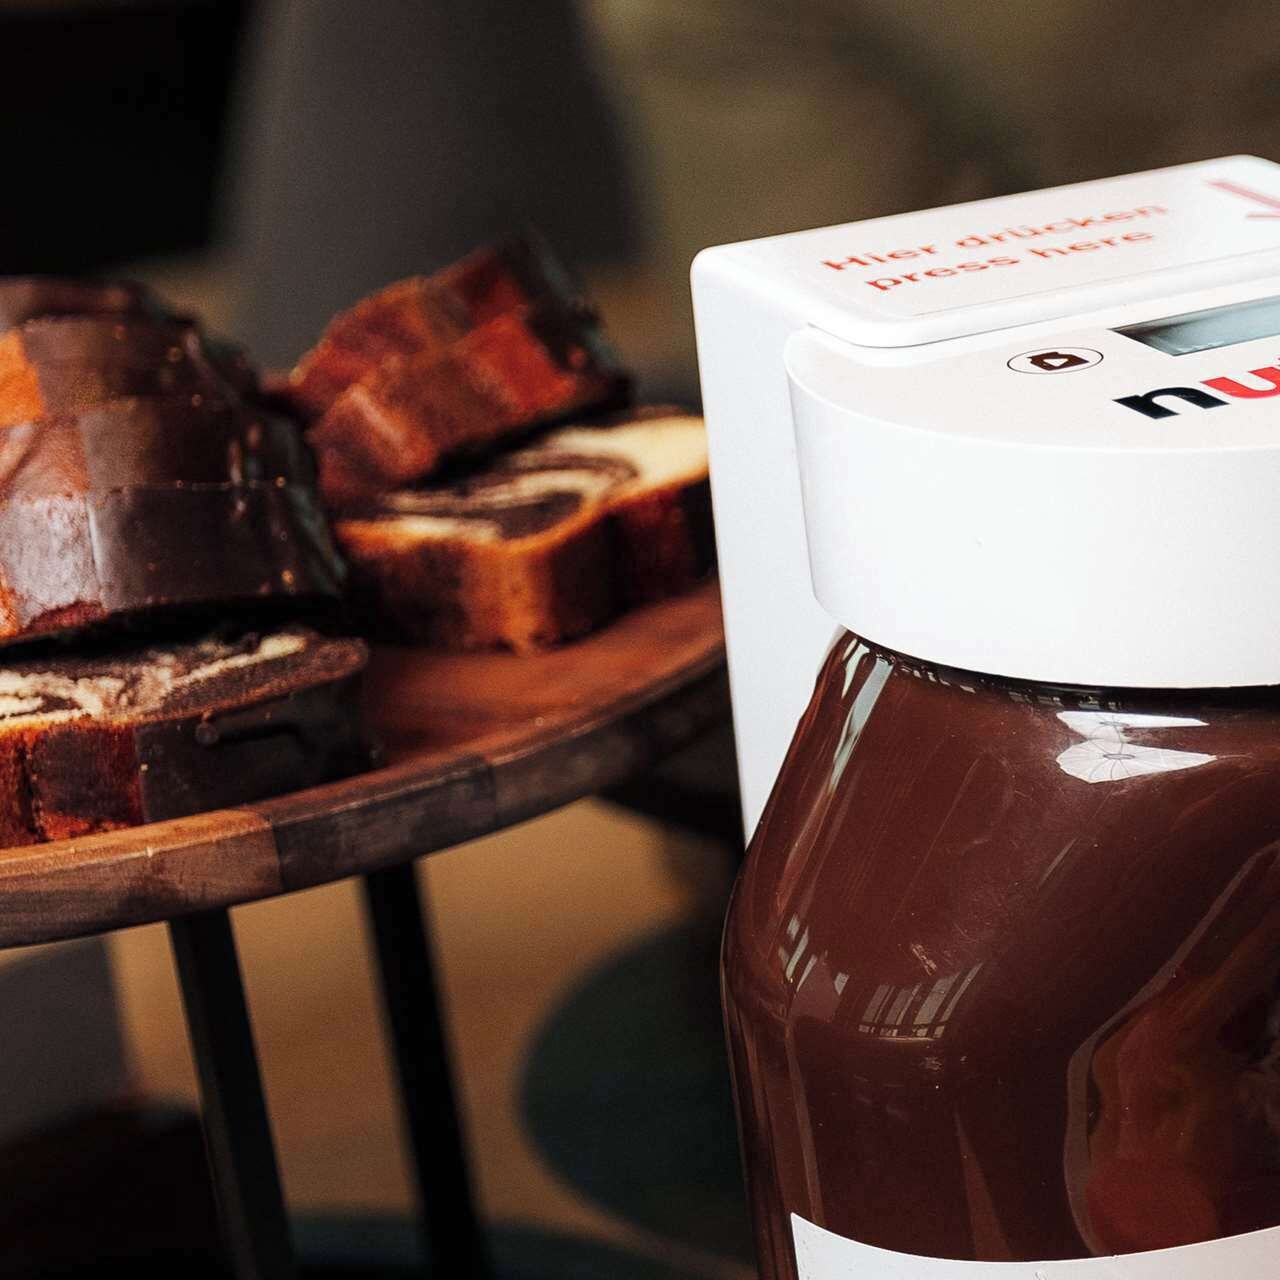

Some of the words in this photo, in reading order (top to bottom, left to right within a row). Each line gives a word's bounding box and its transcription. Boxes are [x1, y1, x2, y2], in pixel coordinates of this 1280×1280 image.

[820, 243, 940, 272] Hier
[864, 255, 1021, 292] press
[1025, 230, 1155, 260] here
